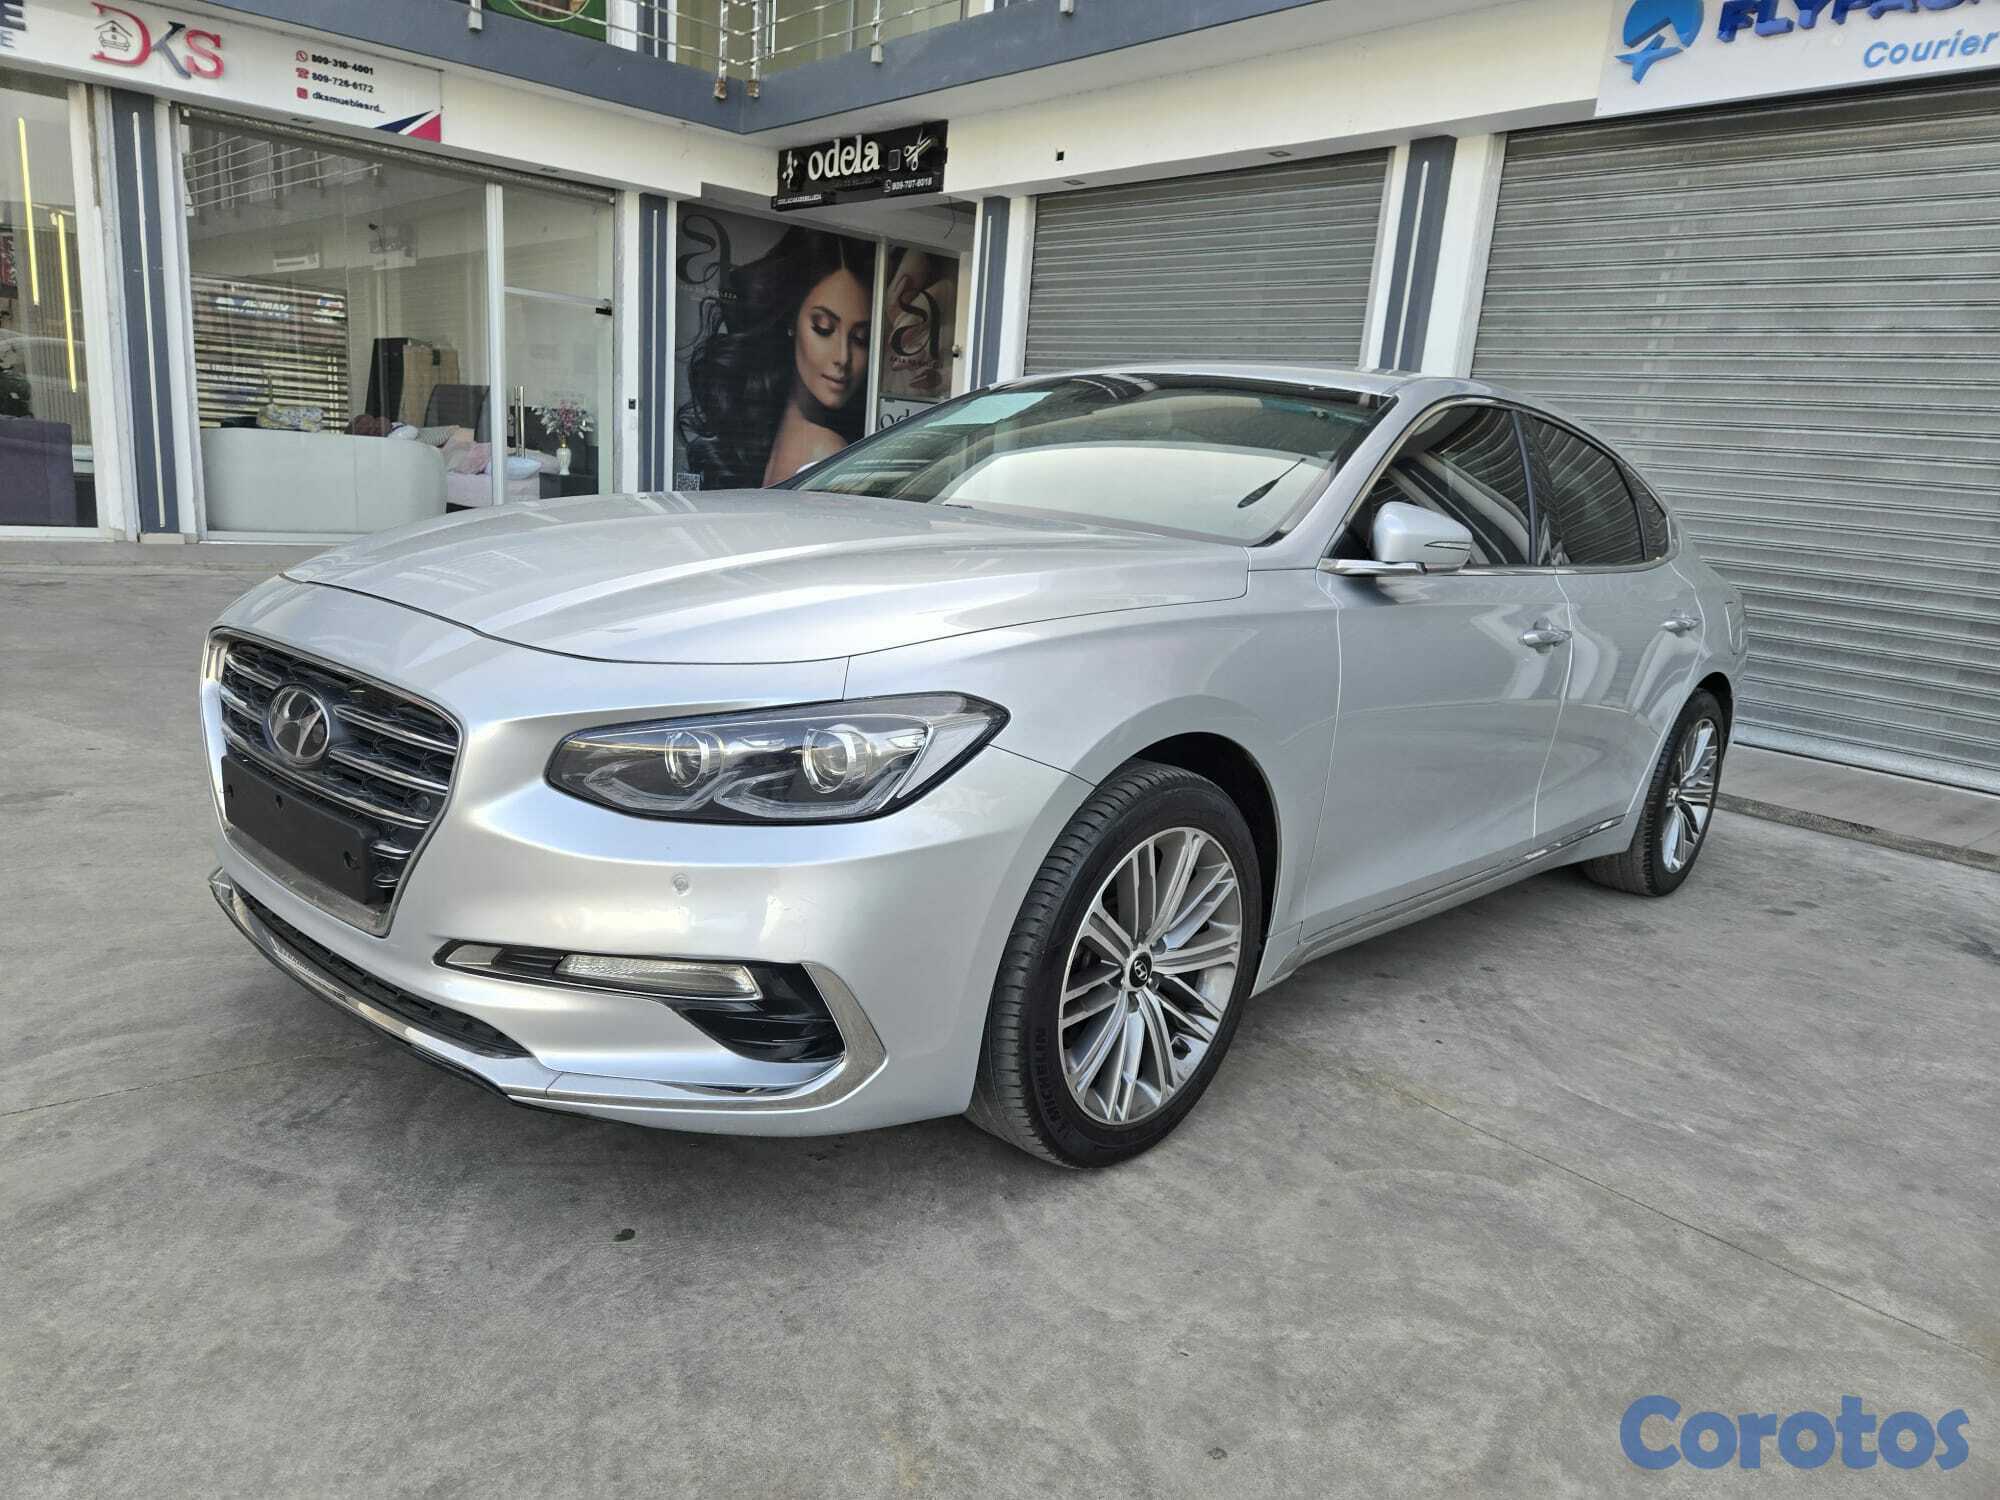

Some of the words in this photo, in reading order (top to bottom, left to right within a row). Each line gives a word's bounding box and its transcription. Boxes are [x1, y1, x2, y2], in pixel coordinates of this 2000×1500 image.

[90, 1, 224, 79] DKS
[1863, 28, 1999, 68] Courier
[807, 134, 880, 181] odela
